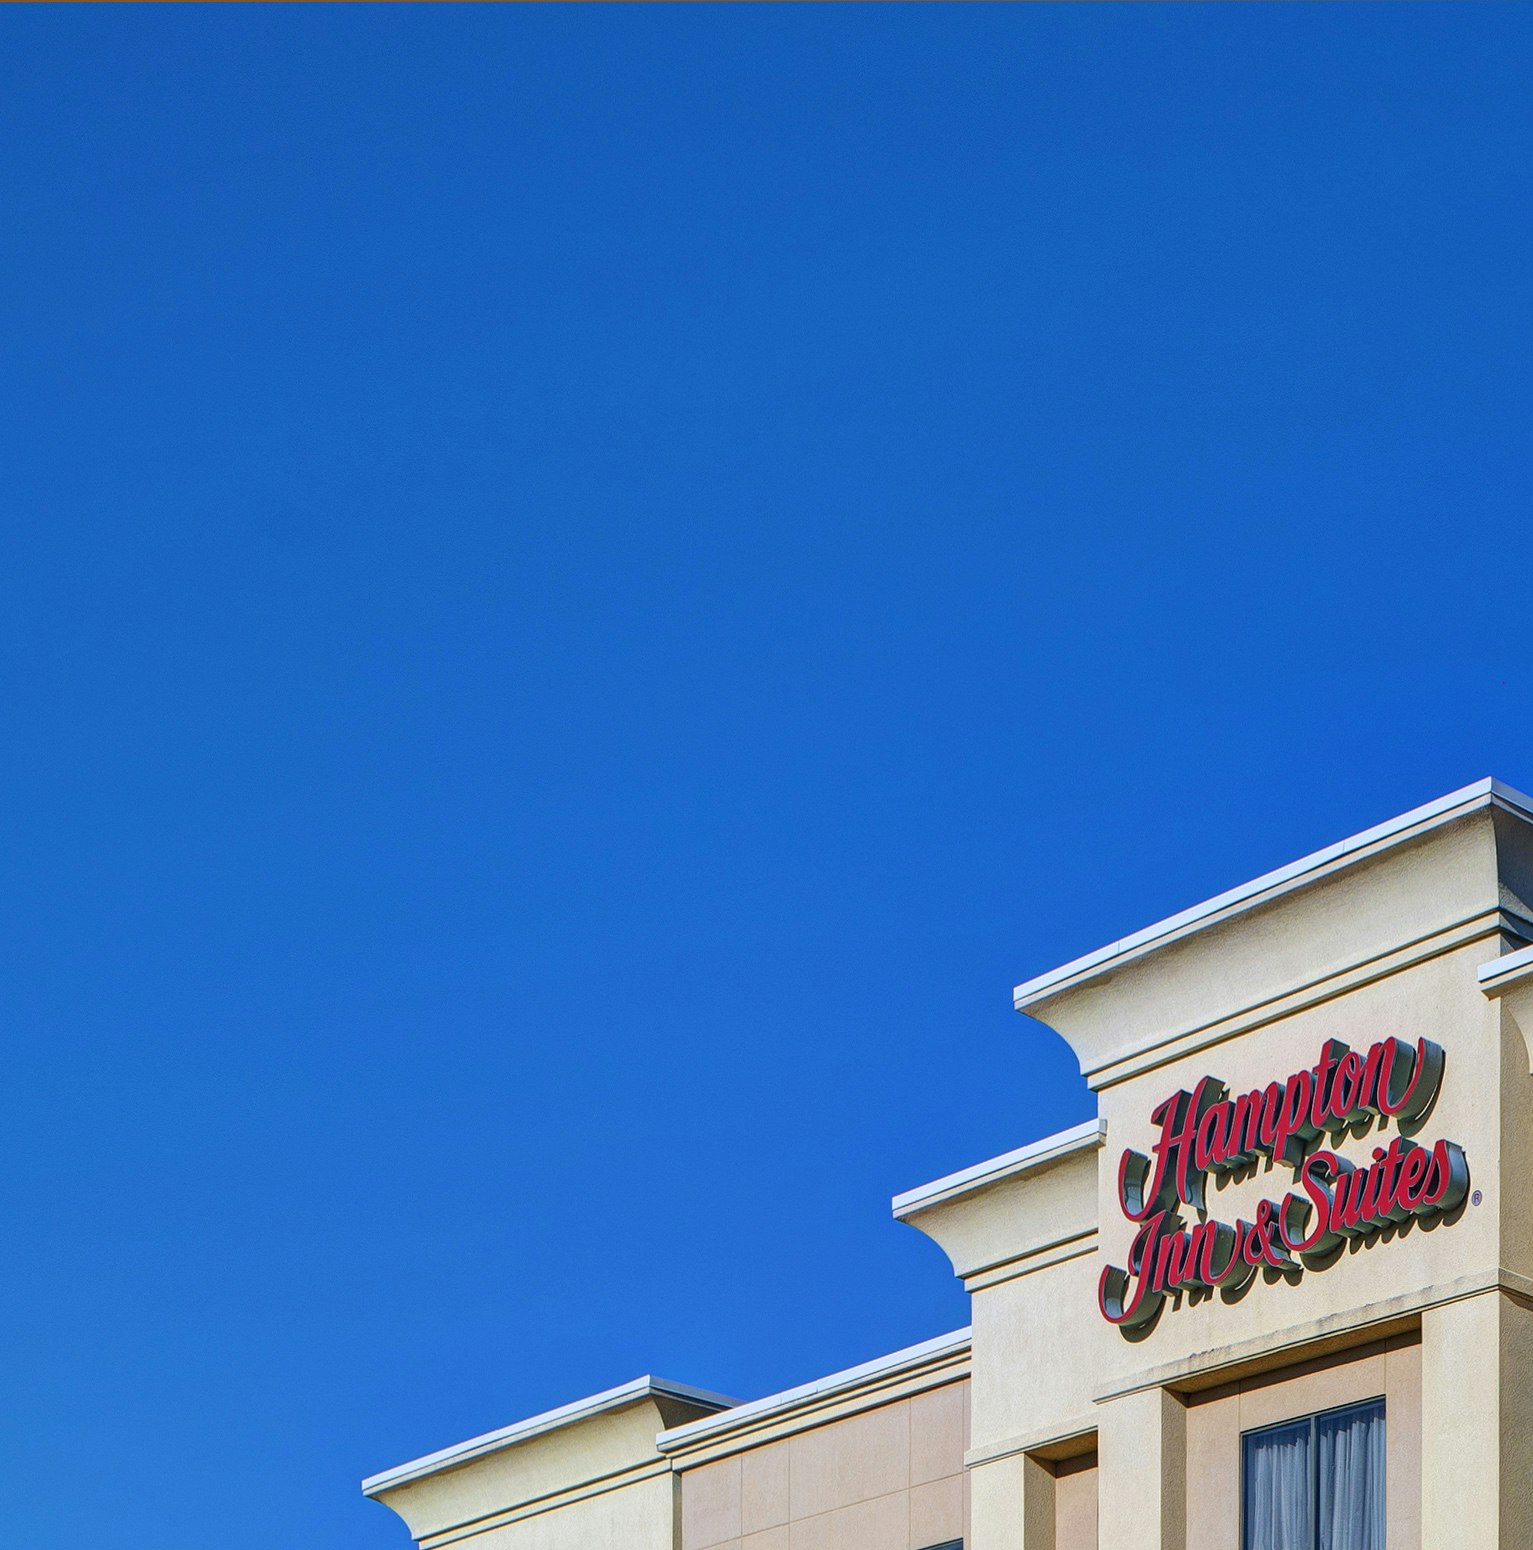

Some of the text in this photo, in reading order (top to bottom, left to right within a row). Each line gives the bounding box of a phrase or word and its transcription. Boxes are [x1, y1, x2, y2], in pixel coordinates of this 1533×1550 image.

[1118, 1036, 1427, 1221] Hampton
[1099, 1210, 1244, 1325] Inn
[1244, 1199, 1286, 1267] &
[1280, 1138, 1454, 1252] Suites
